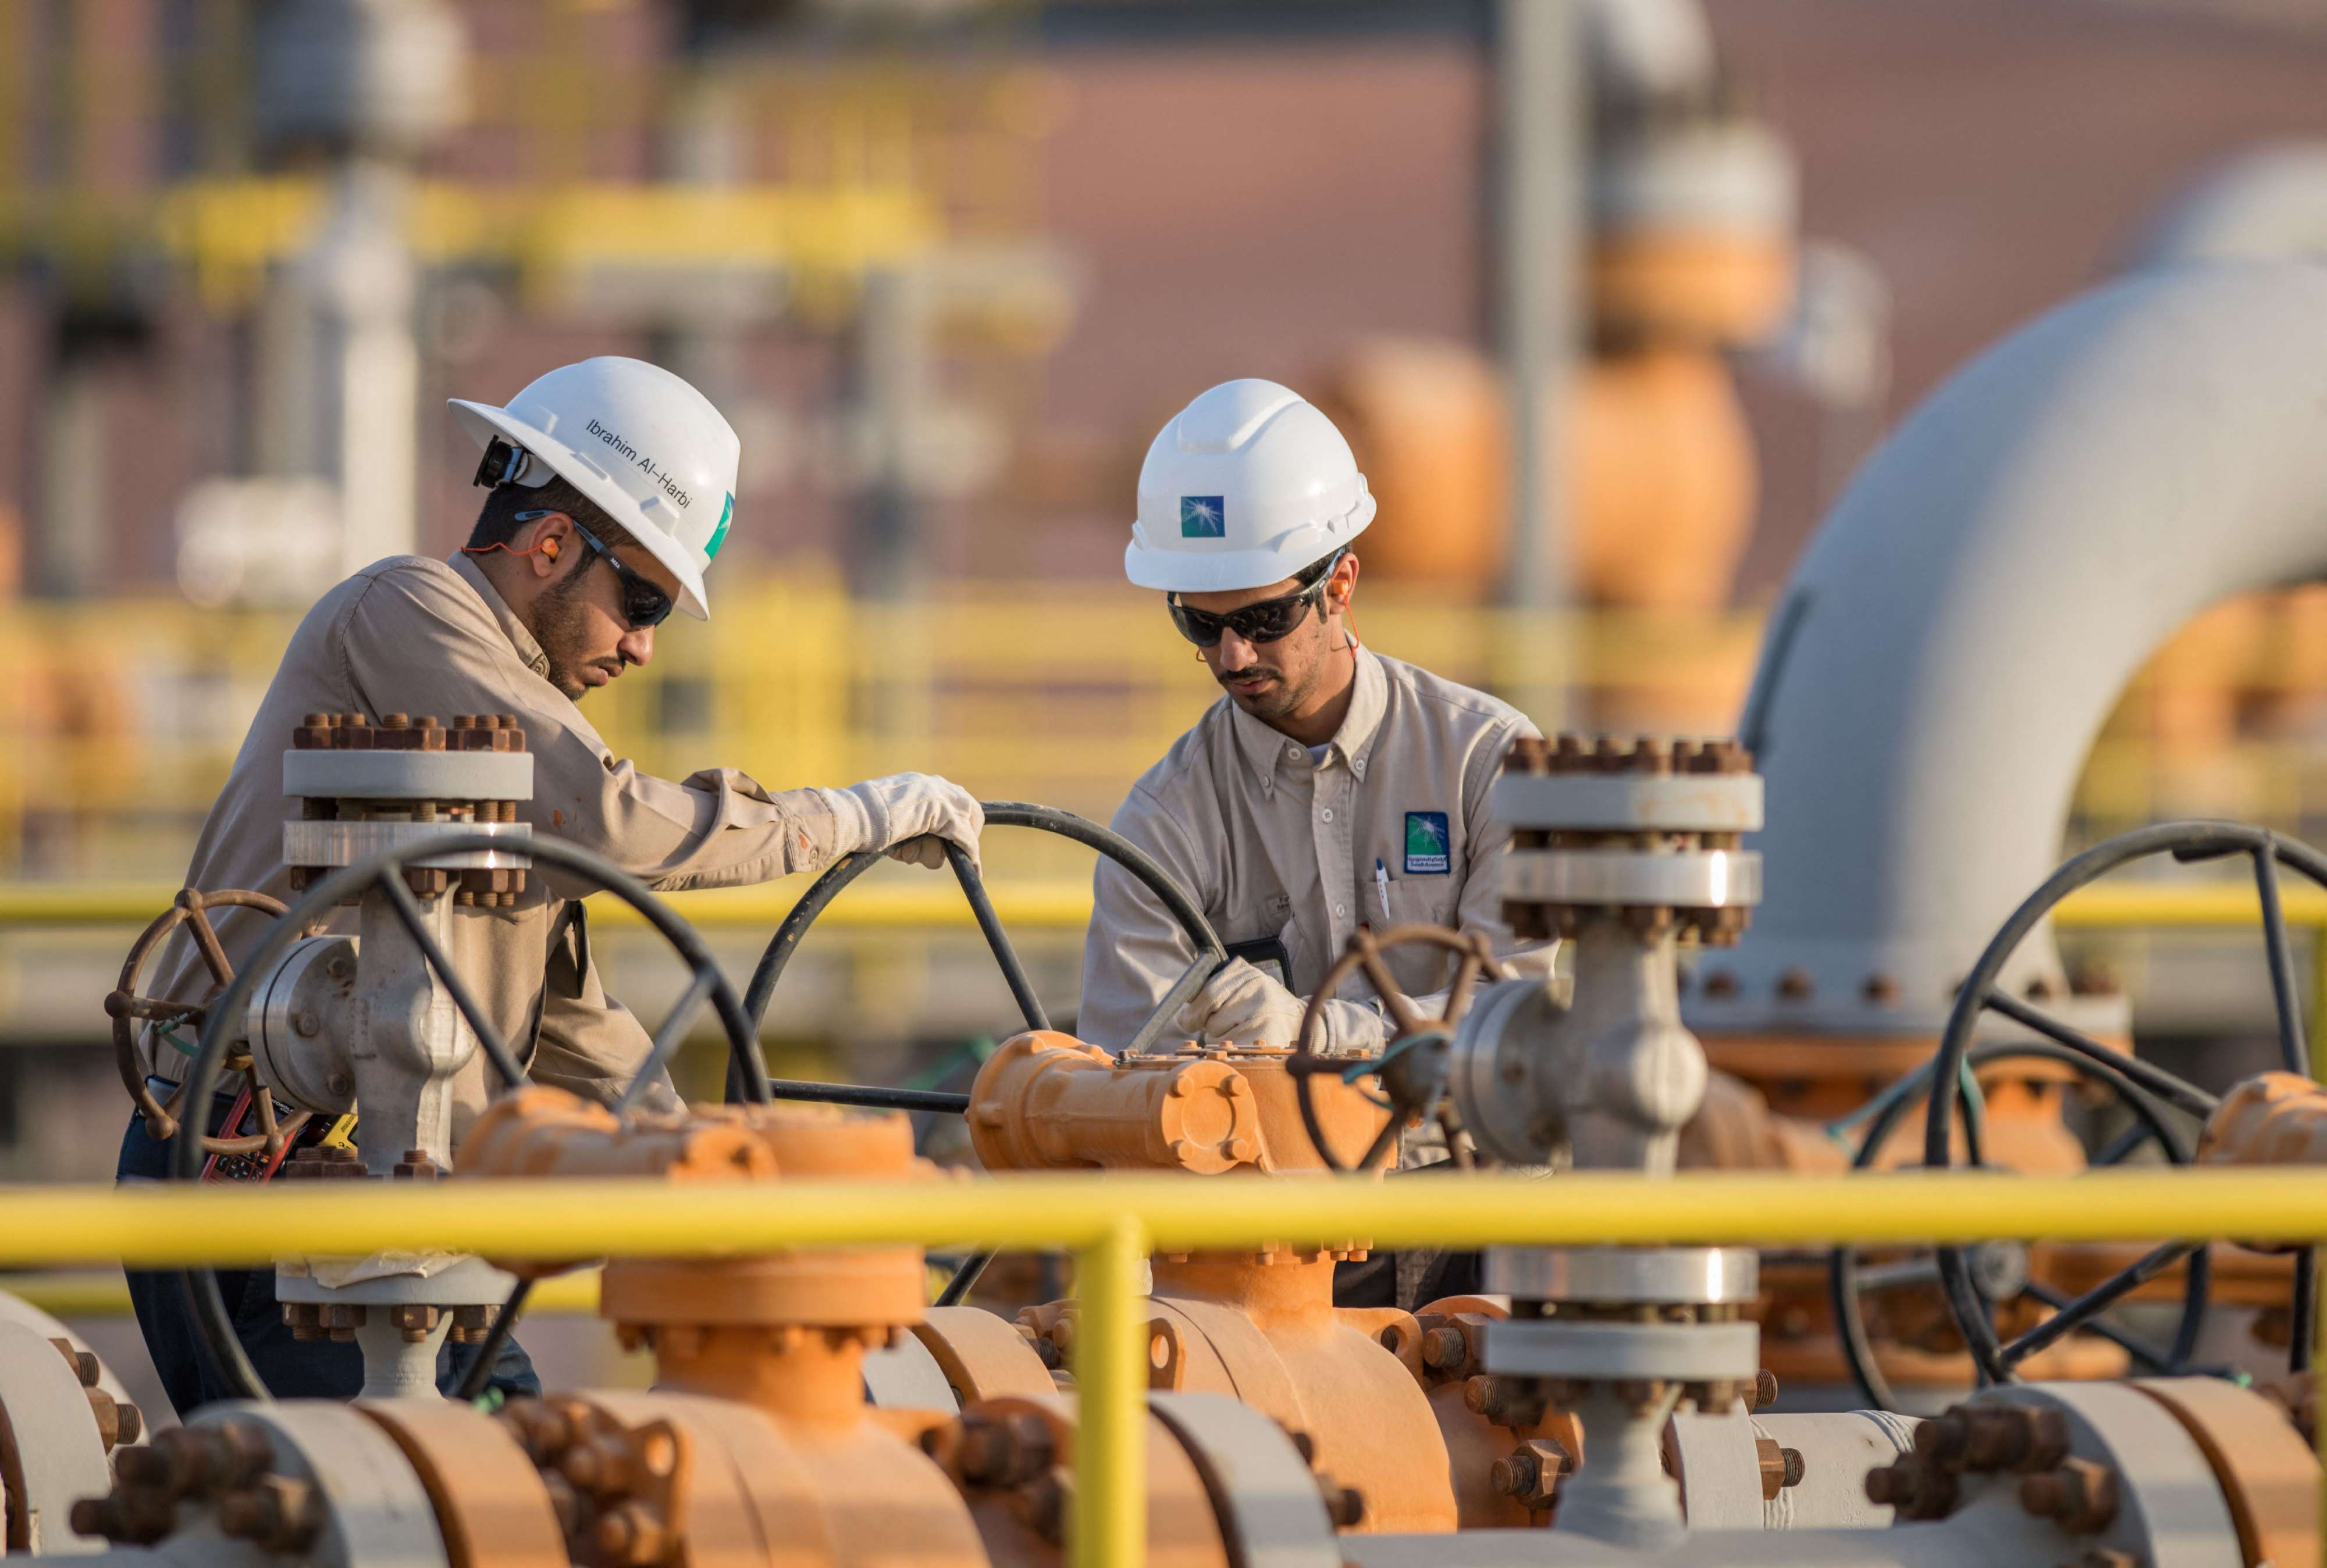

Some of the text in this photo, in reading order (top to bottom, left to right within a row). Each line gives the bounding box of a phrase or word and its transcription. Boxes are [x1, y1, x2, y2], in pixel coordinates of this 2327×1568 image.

[586, 419, 693, 509] Ibrahim Al-Harbi
[271, 1099, 294, 1113] TOROL
